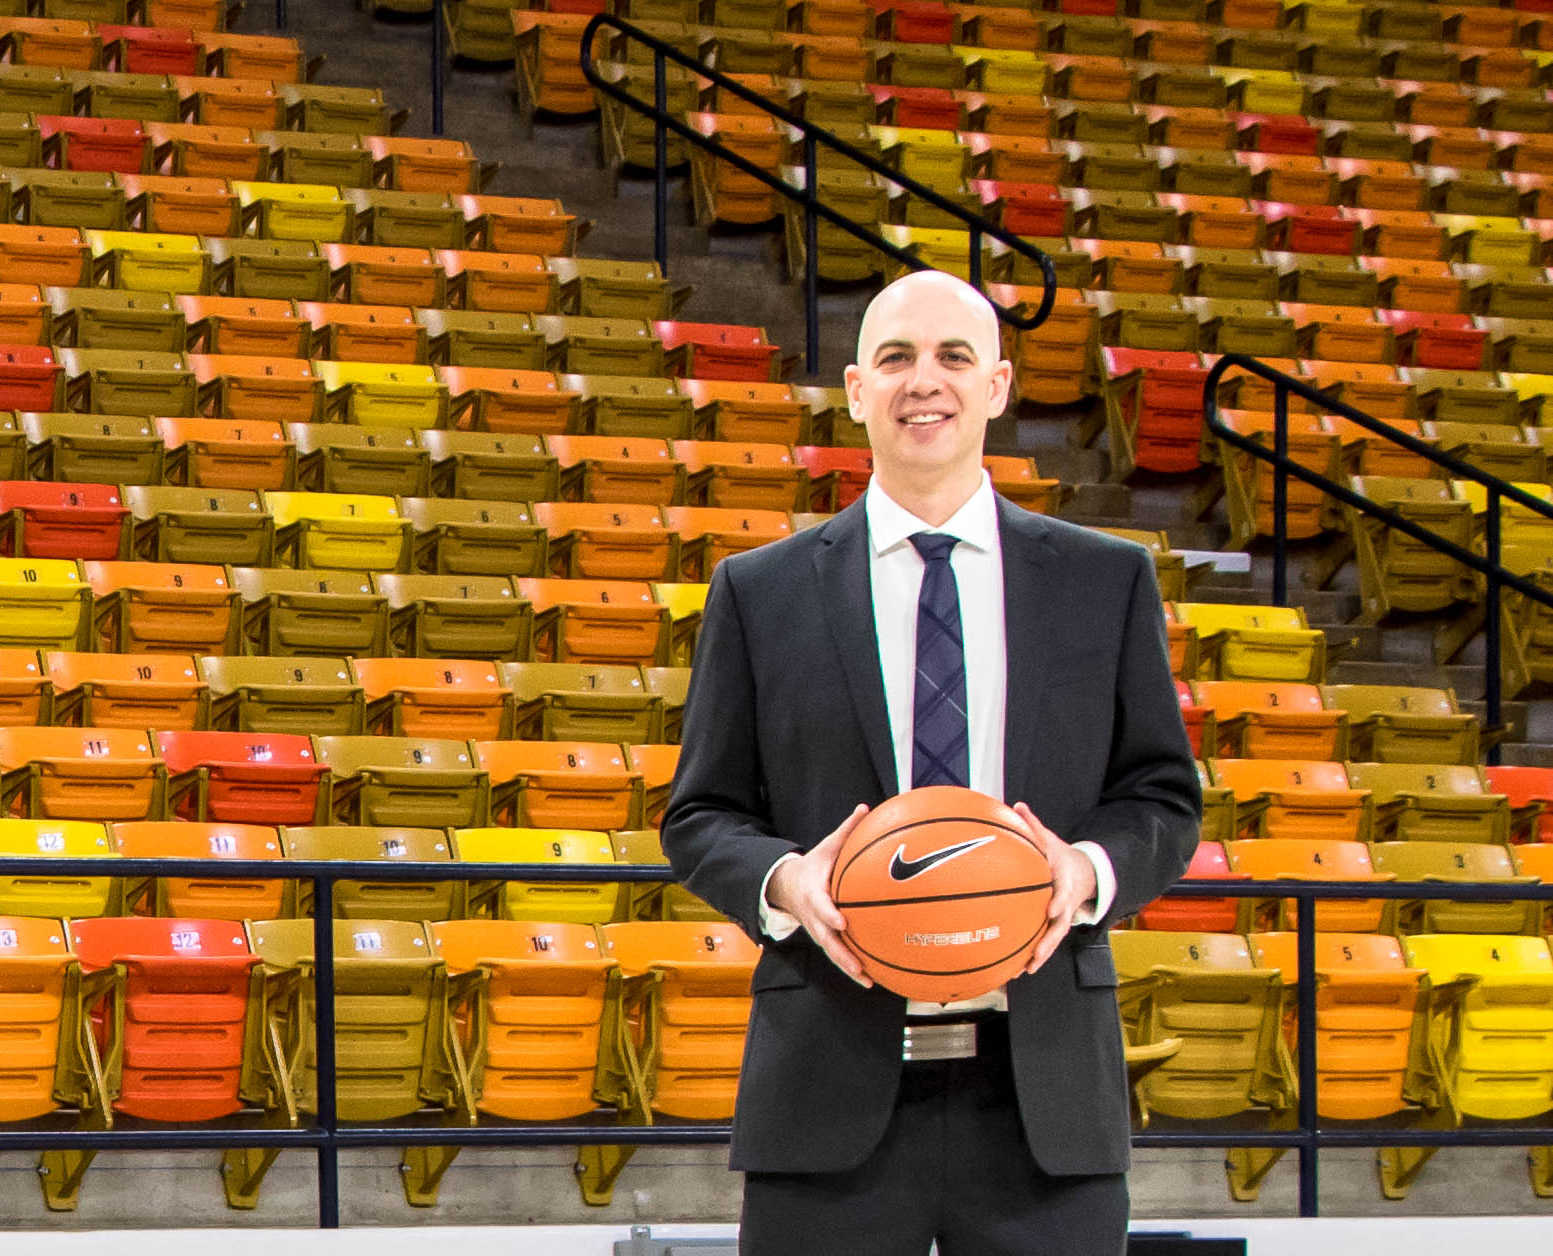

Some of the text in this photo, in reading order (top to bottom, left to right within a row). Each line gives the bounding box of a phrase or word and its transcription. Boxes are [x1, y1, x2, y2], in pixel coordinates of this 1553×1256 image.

[69, 492, 79, 506] 9
[209, 498, 219, 512] 8
[348, 504, 356, 517] 7
[480, 510, 490, 523] 6
[612, 513, 622, 527] 5
[741, 518, 751, 532] 4
[22, 569, 38, 583] 10
[173, 574, 183, 588] 9
[460, 585, 468, 599] 7
[600, 591, 609, 604] 6
[136, 666, 152, 680] 10
[293, 668, 304, 683] 9
[443, 670, 453, 685] 8
[587, 675, 596, 689] 7
[88, 740, 102, 755] 11
[412, 749, 423, 765] 9
[567, 753, 577, 768] 8
[42, 834, 58, 848] 12
[214, 836, 229, 853] 11
[552, 842, 563, 858] 9
[176, 933, 193, 947] 12
[531, 936, 549, 952] 10
[704, 935, 716, 952] 9
